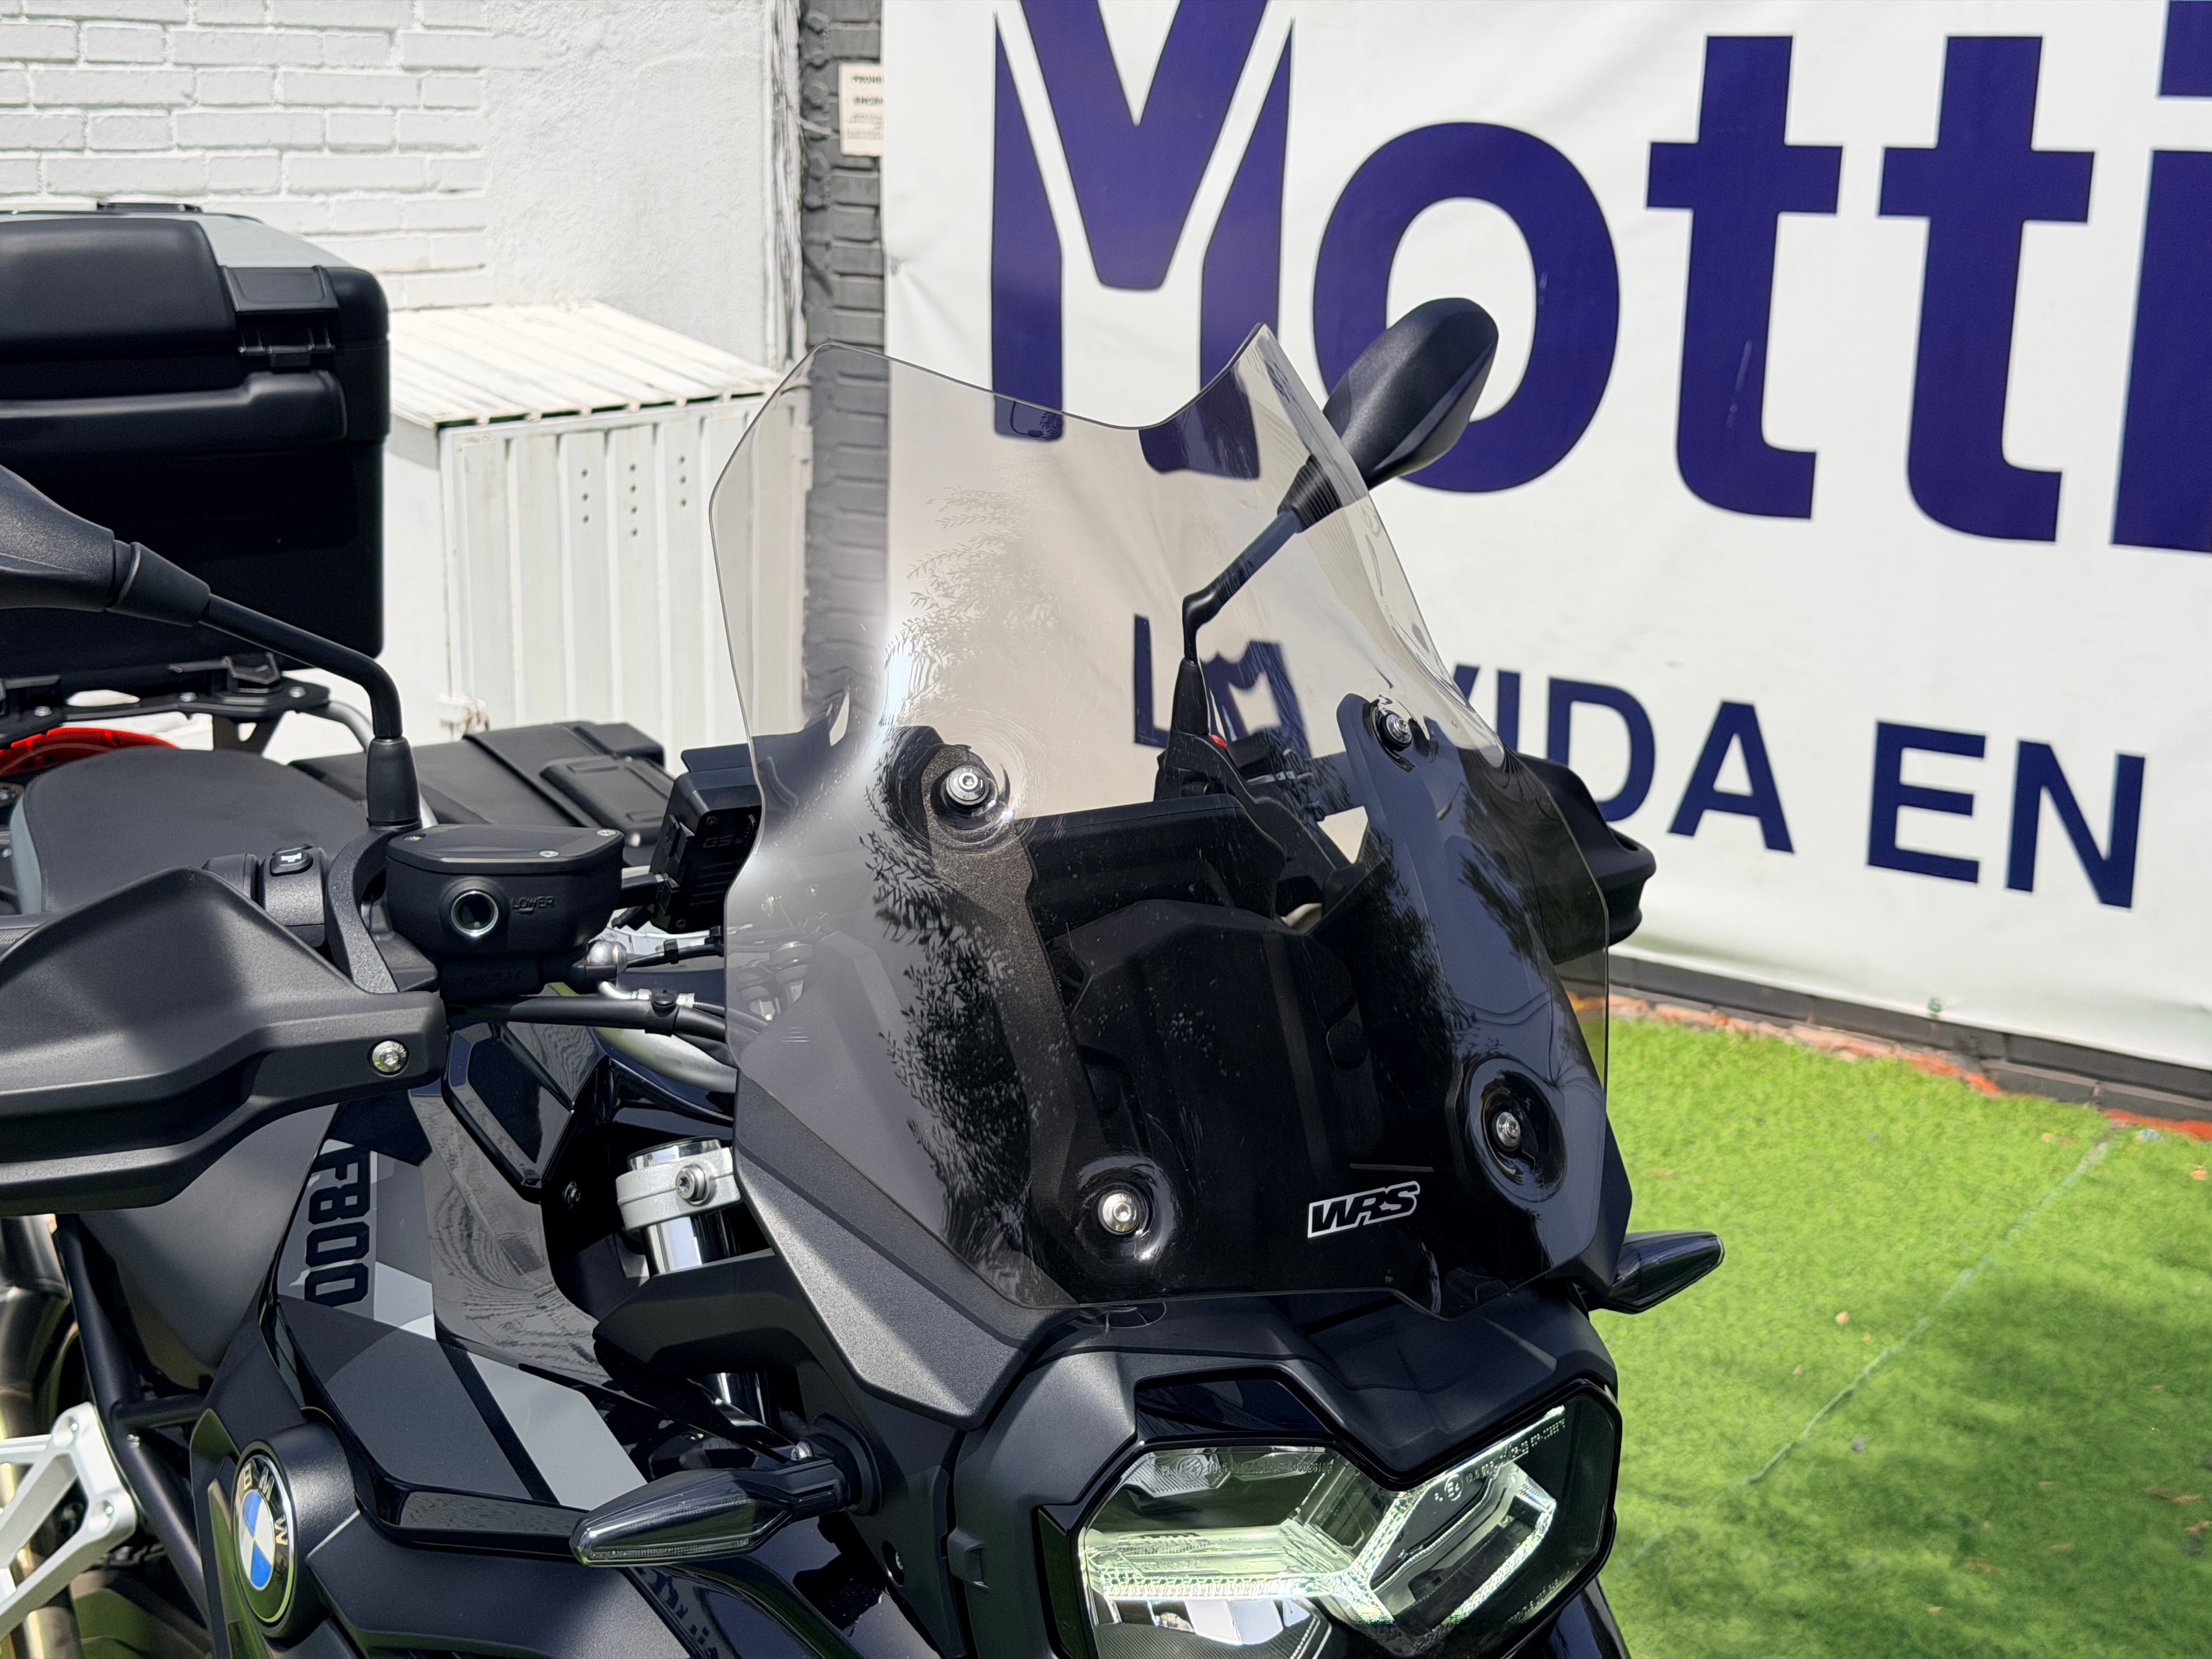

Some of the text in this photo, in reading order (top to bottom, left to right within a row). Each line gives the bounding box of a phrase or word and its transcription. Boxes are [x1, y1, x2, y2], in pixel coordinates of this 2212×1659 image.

[1453, 663, 1795, 854] IDA
[1866, 720, 2146, 909] EN
[511, 895, 555, 910] LOWER
[304, 1144, 371, 1308] F800
[1307, 1181, 1421, 1238] WRS
[243, 1460, 289, 1546] BMW
